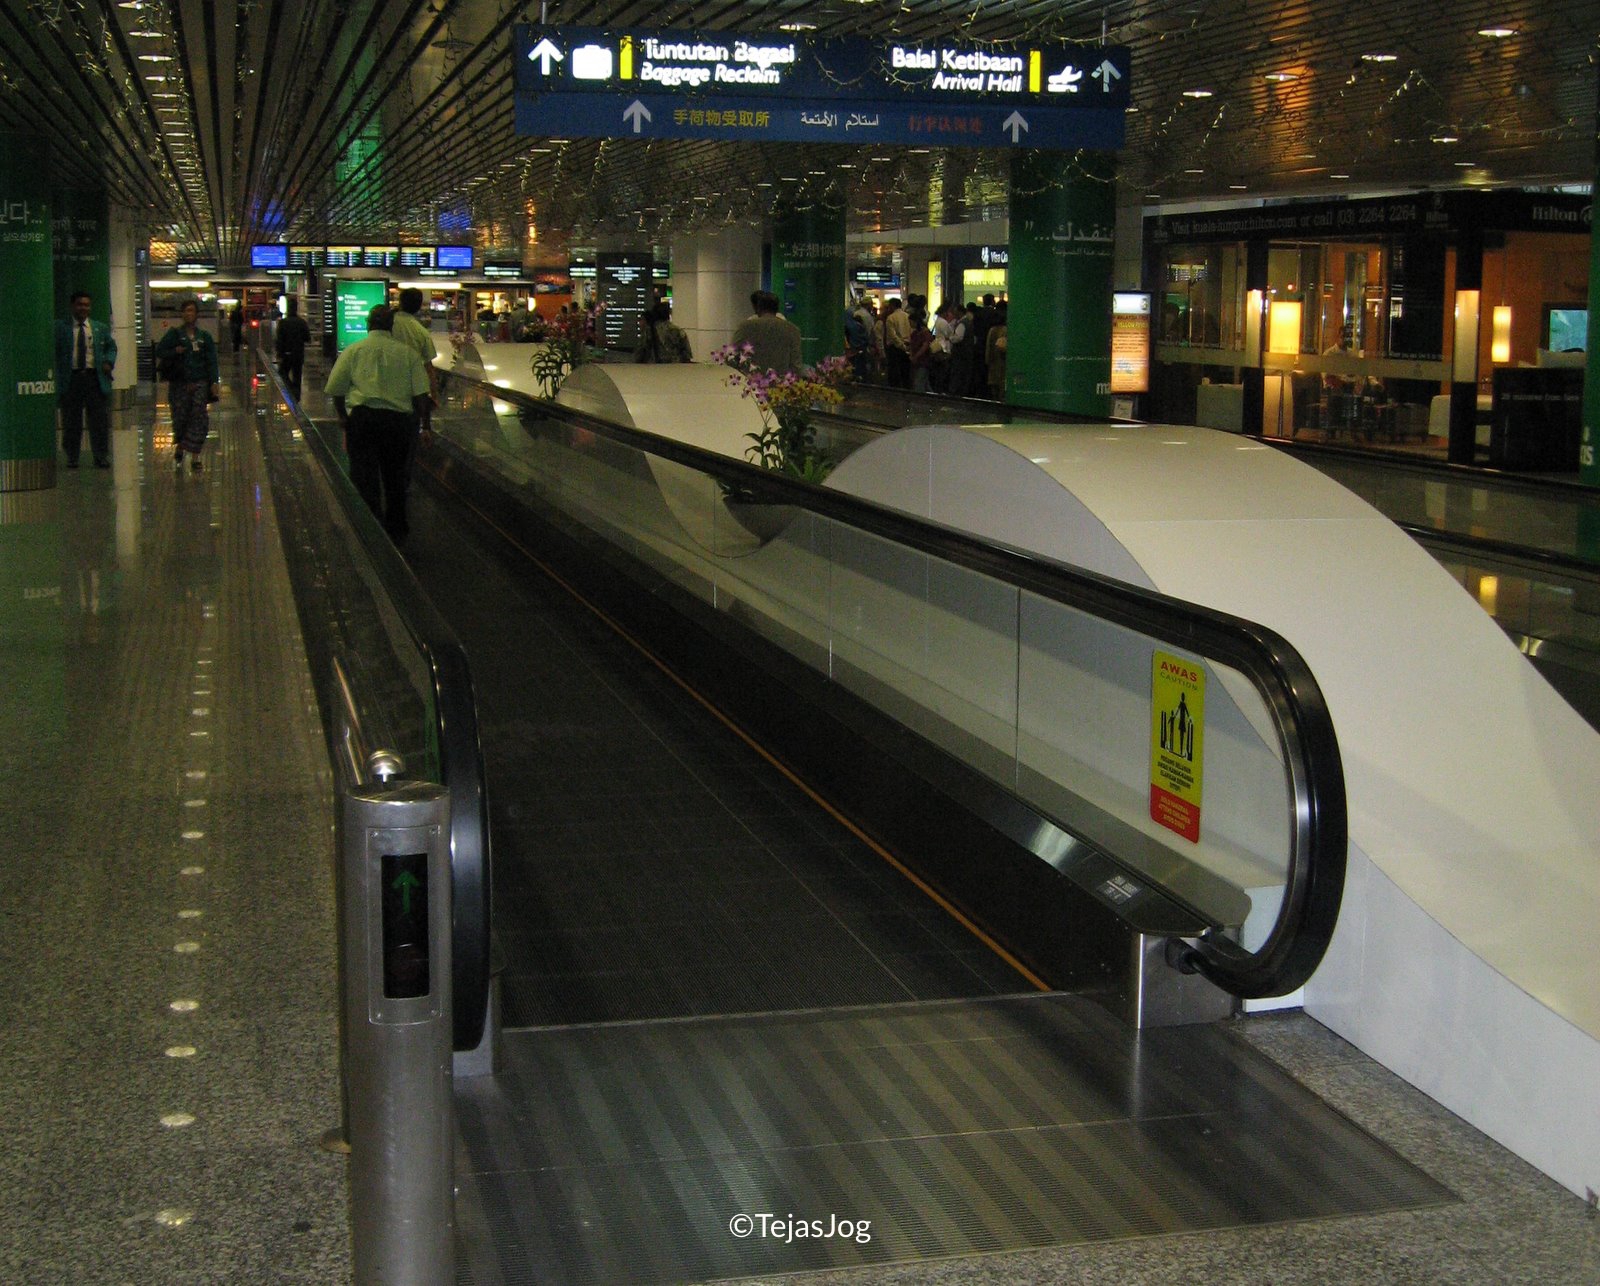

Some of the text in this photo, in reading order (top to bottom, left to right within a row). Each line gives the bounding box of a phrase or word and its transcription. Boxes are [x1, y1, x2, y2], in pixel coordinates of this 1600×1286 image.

[641, 38, 795, 68] Tuntutan Bagasi
[892, 48, 1023, 71] Balai Ketibaan
[640, 62, 780, 87] Baggage Reclaim
[932, 72, 1023, 92] Arrival Hall
[673, 108, 771, 128] 手荷物受取所
[800, 110, 879, 131] استلام الأمتعة
[1532, 206, 1577, 221] Hilton
[1161, 660, 1198, 682] AWAS
